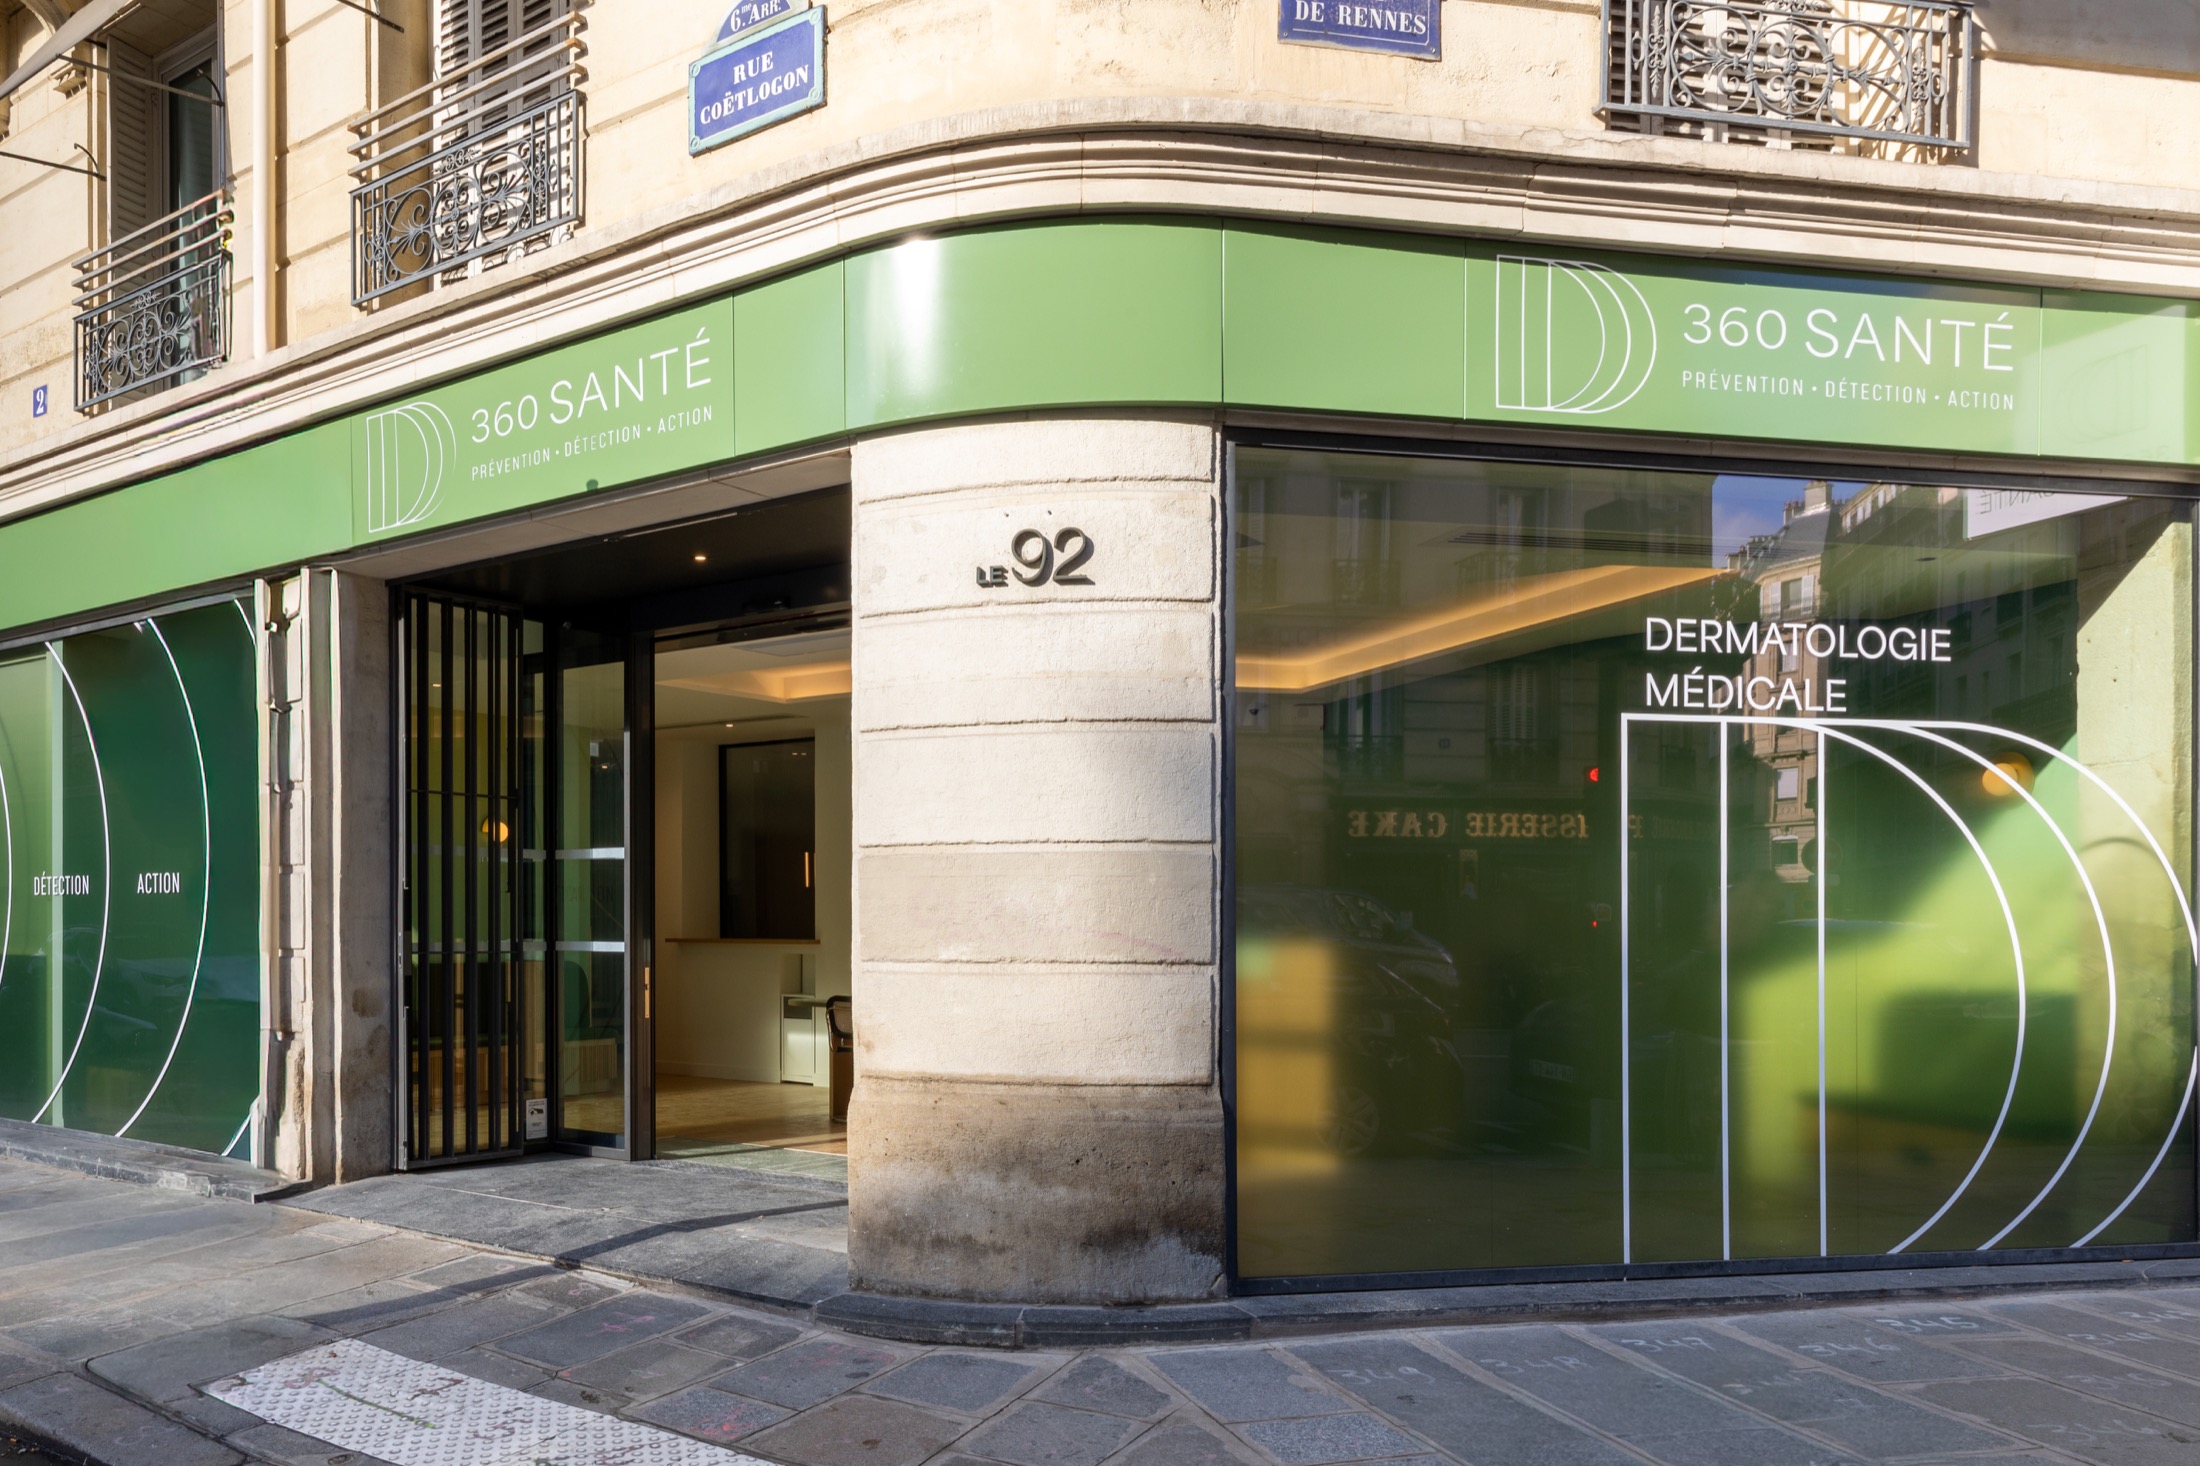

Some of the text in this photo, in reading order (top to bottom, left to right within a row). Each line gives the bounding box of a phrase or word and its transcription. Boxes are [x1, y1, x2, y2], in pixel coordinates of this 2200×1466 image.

[1295, 0, 1427, 35] DE RENNES
[733, 51, 774, 84] RUE
[700, 64, 809, 125] COËTLOGON
[1683, 302, 2015, 371] 360 SANTÉ
[36, 389, 44, 415] 2
[471, 327, 712, 443] 360 SANTÉ
[1682, 368, 2015, 411] PRÉVENTION DÉTECTION ACTION
[471, 405, 713, 481] PRÉVENTION DÉTECTION ACTION
[976, 527, 1093, 587] LE 92
[1645, 616, 1952, 662] DERMATOLOGIE
[1645, 666, 1847, 712] MÉDICALE
[33, 870, 90, 896] DÉTECTION
[136, 872, 180, 894] ACTION
[1874, 1316, 1980, 1333] 345
[1620, 1336, 1718, 1353] 347
[1797, 1336, 1902, 1357] 346
[1325, 1366, 1437, 1385] 349
